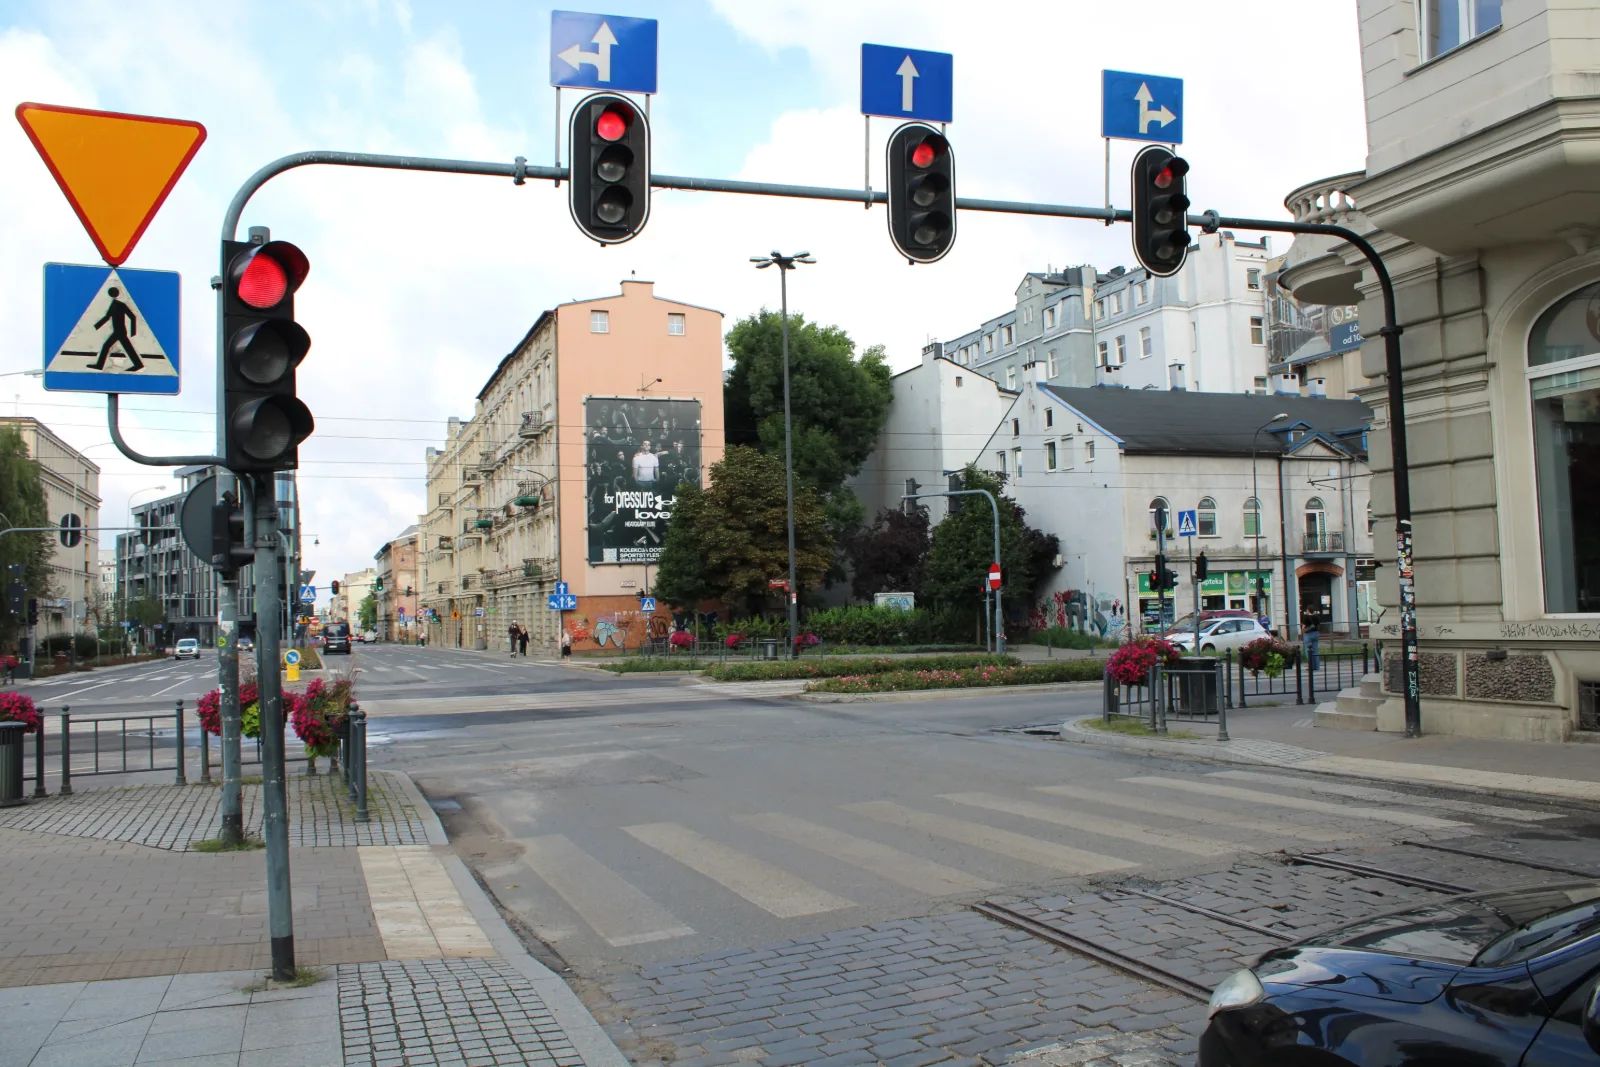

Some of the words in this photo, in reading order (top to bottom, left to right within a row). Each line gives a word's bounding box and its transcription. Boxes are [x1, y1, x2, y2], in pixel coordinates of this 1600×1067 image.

[1343, 335, 1352, 344] od
[1353, 333, 1364, 342] 10
[604, 493, 614, 504] for
[616, 491, 654, 515] pressure
[634, 509, 673, 519] love
